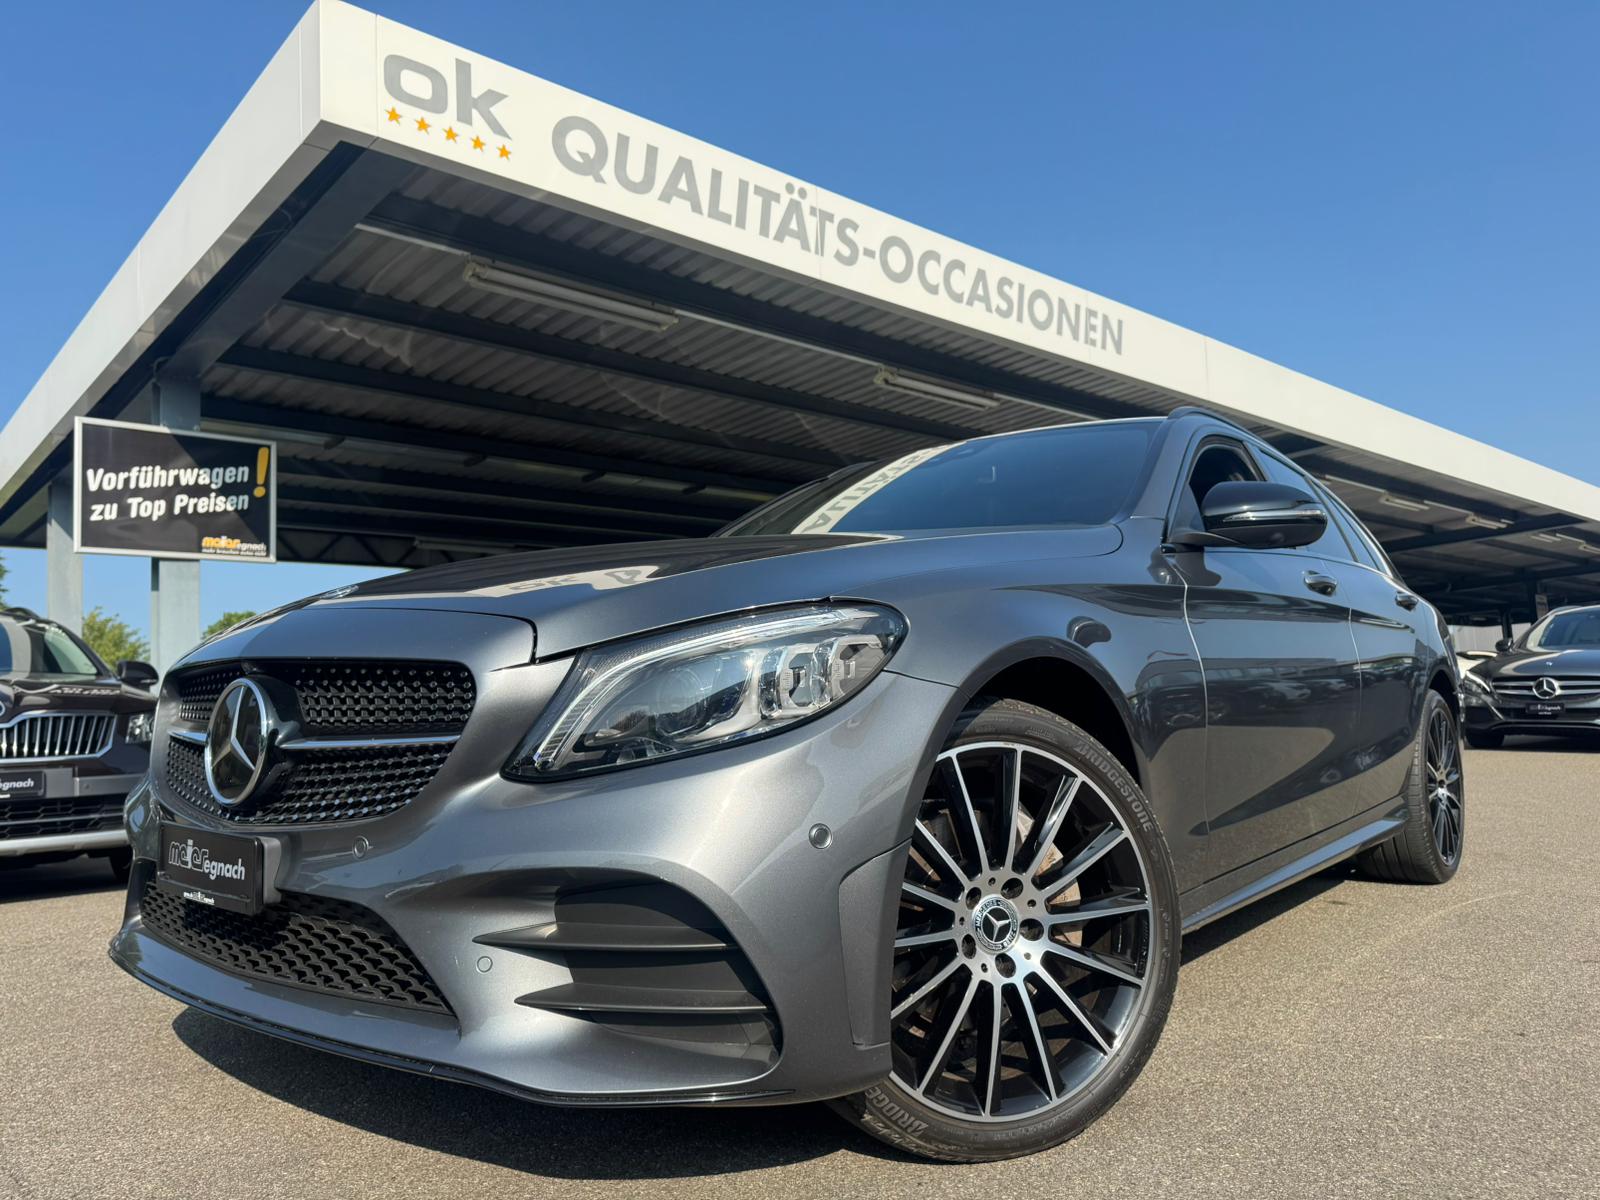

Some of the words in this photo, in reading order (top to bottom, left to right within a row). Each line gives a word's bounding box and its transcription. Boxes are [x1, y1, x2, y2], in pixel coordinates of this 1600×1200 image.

[551, 115, 1123, 355] QUALITÄTS-OCCASIONEN
[86, 465, 249, 492] Vorführwagen
[89, 502, 118, 521] zu
[127, 496, 166, 521] Top
[173, 491, 249, 515] Preisen
[1073, 739, 1154, 832] BRIDGESTONE
